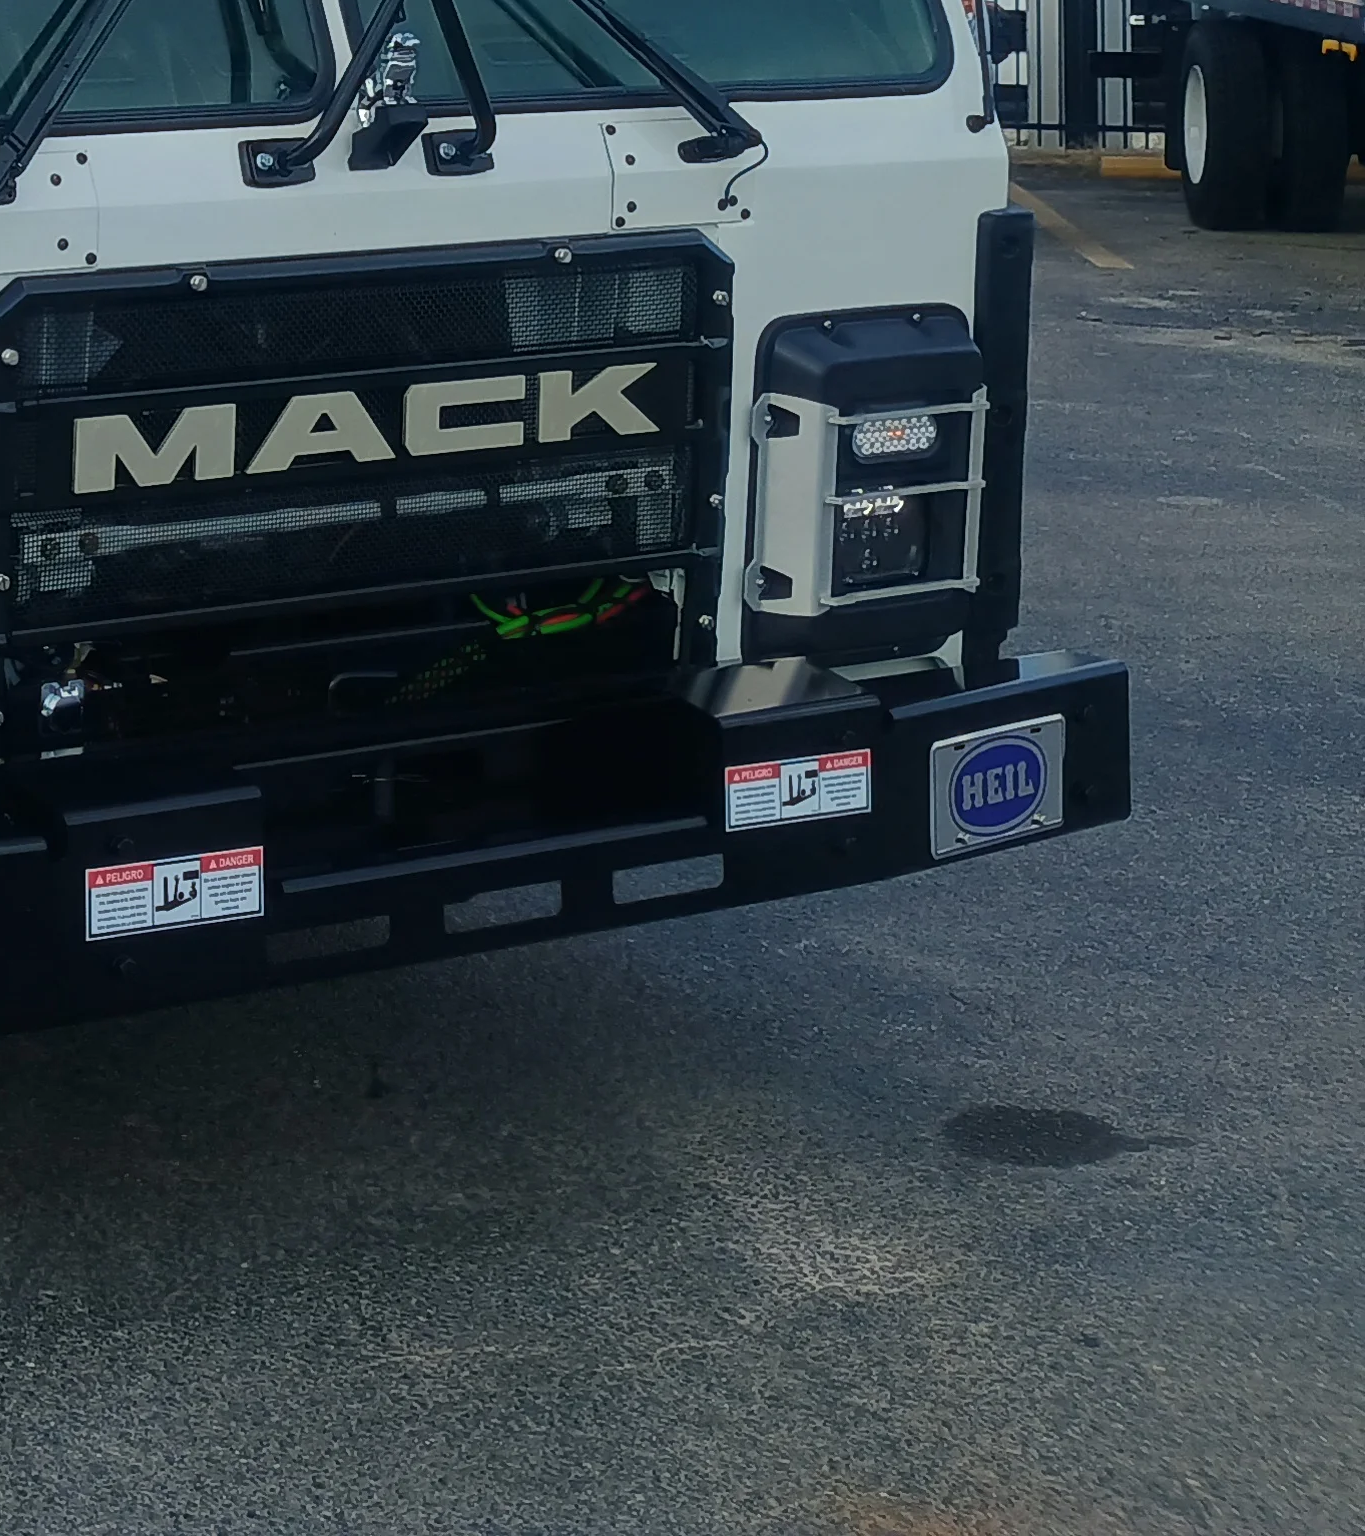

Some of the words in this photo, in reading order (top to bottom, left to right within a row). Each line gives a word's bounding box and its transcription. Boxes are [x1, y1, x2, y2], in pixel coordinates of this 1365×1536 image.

[71, 361, 662, 495] MACK
[741, 767, 773, 781] PELIGRO
[960, 760, 1035, 812] HEIL
[219, 854, 255, 869] DANGER
[105, 869, 145, 884] PELIGRO
